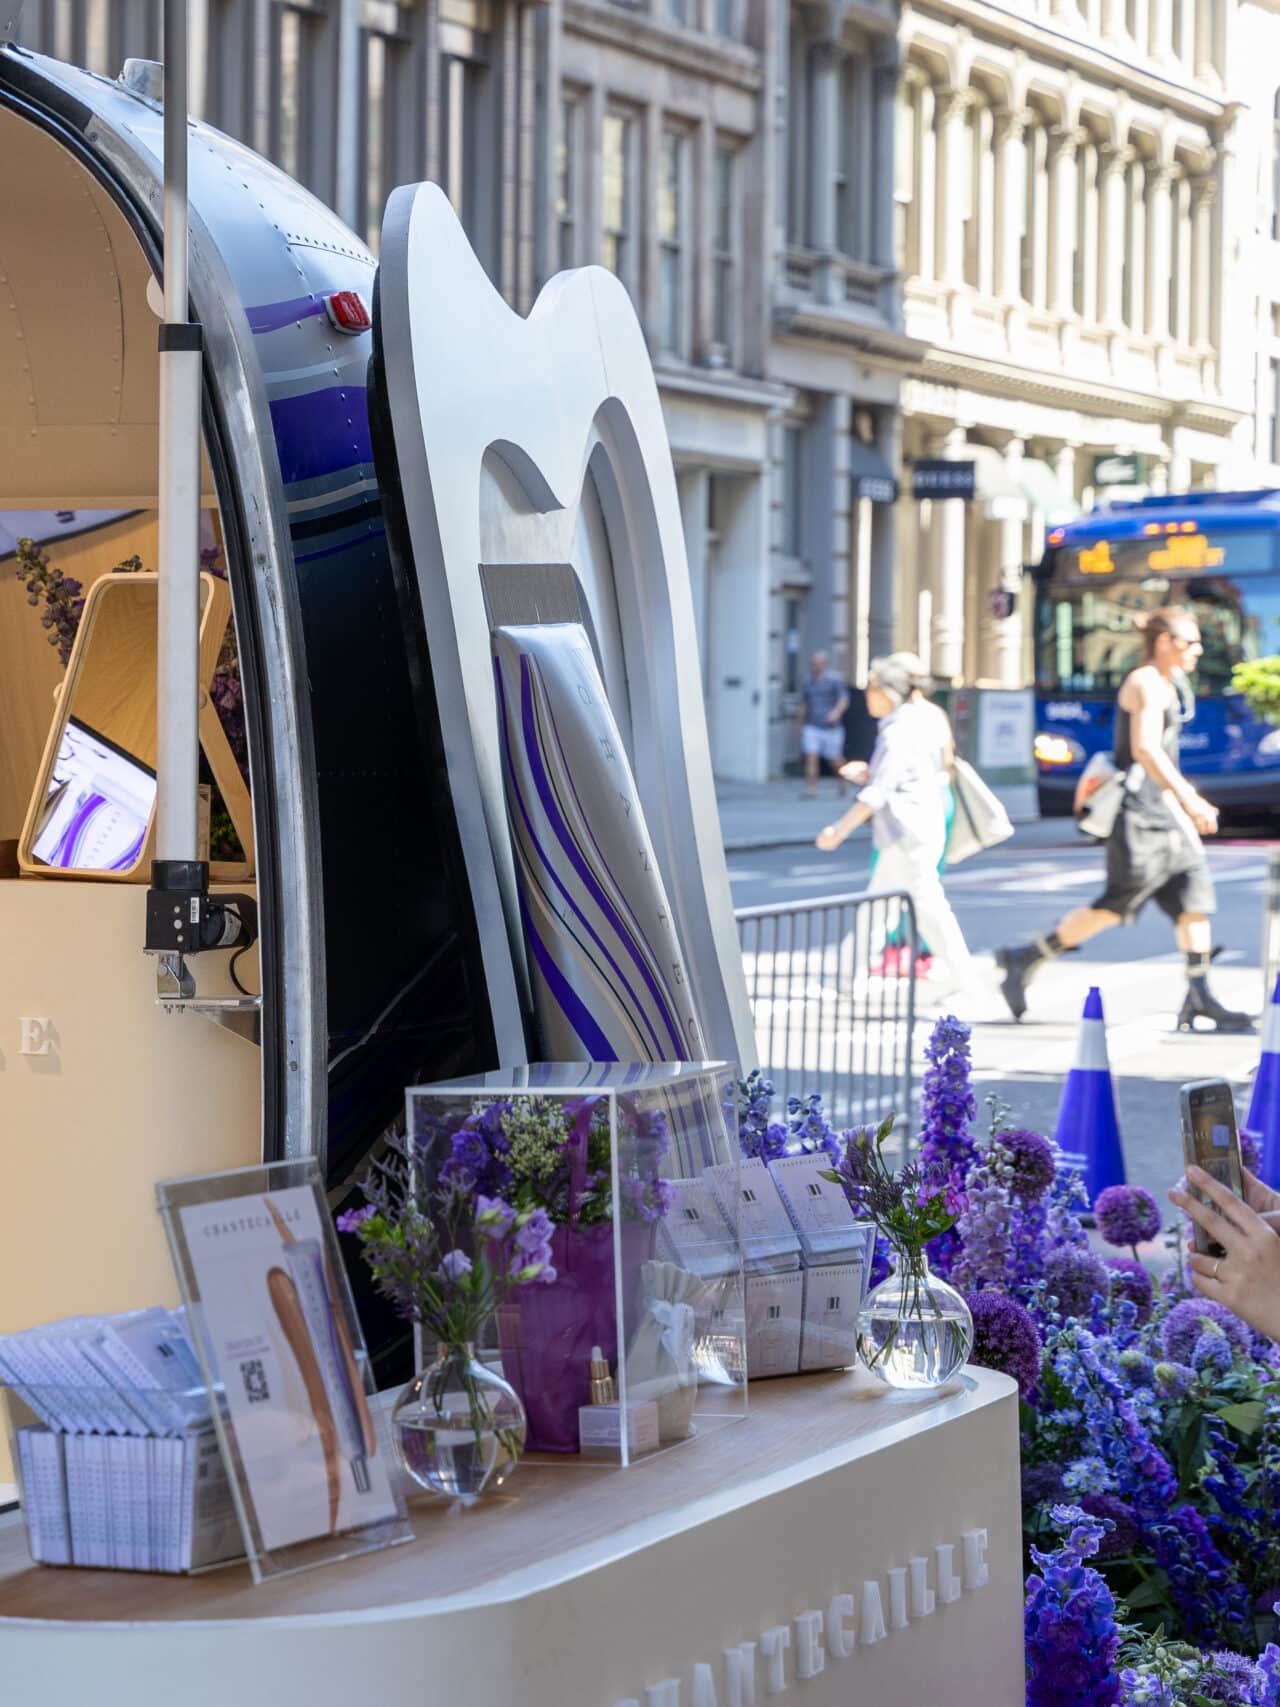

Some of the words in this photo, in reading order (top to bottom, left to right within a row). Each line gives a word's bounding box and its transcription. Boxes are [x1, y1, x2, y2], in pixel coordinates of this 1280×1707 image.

[577, 684, 700, 1041] CHANTEC
[203, 1209, 302, 1238] CHANTECALE
[612, 1527, 990, 1707] ANTECAILLE
